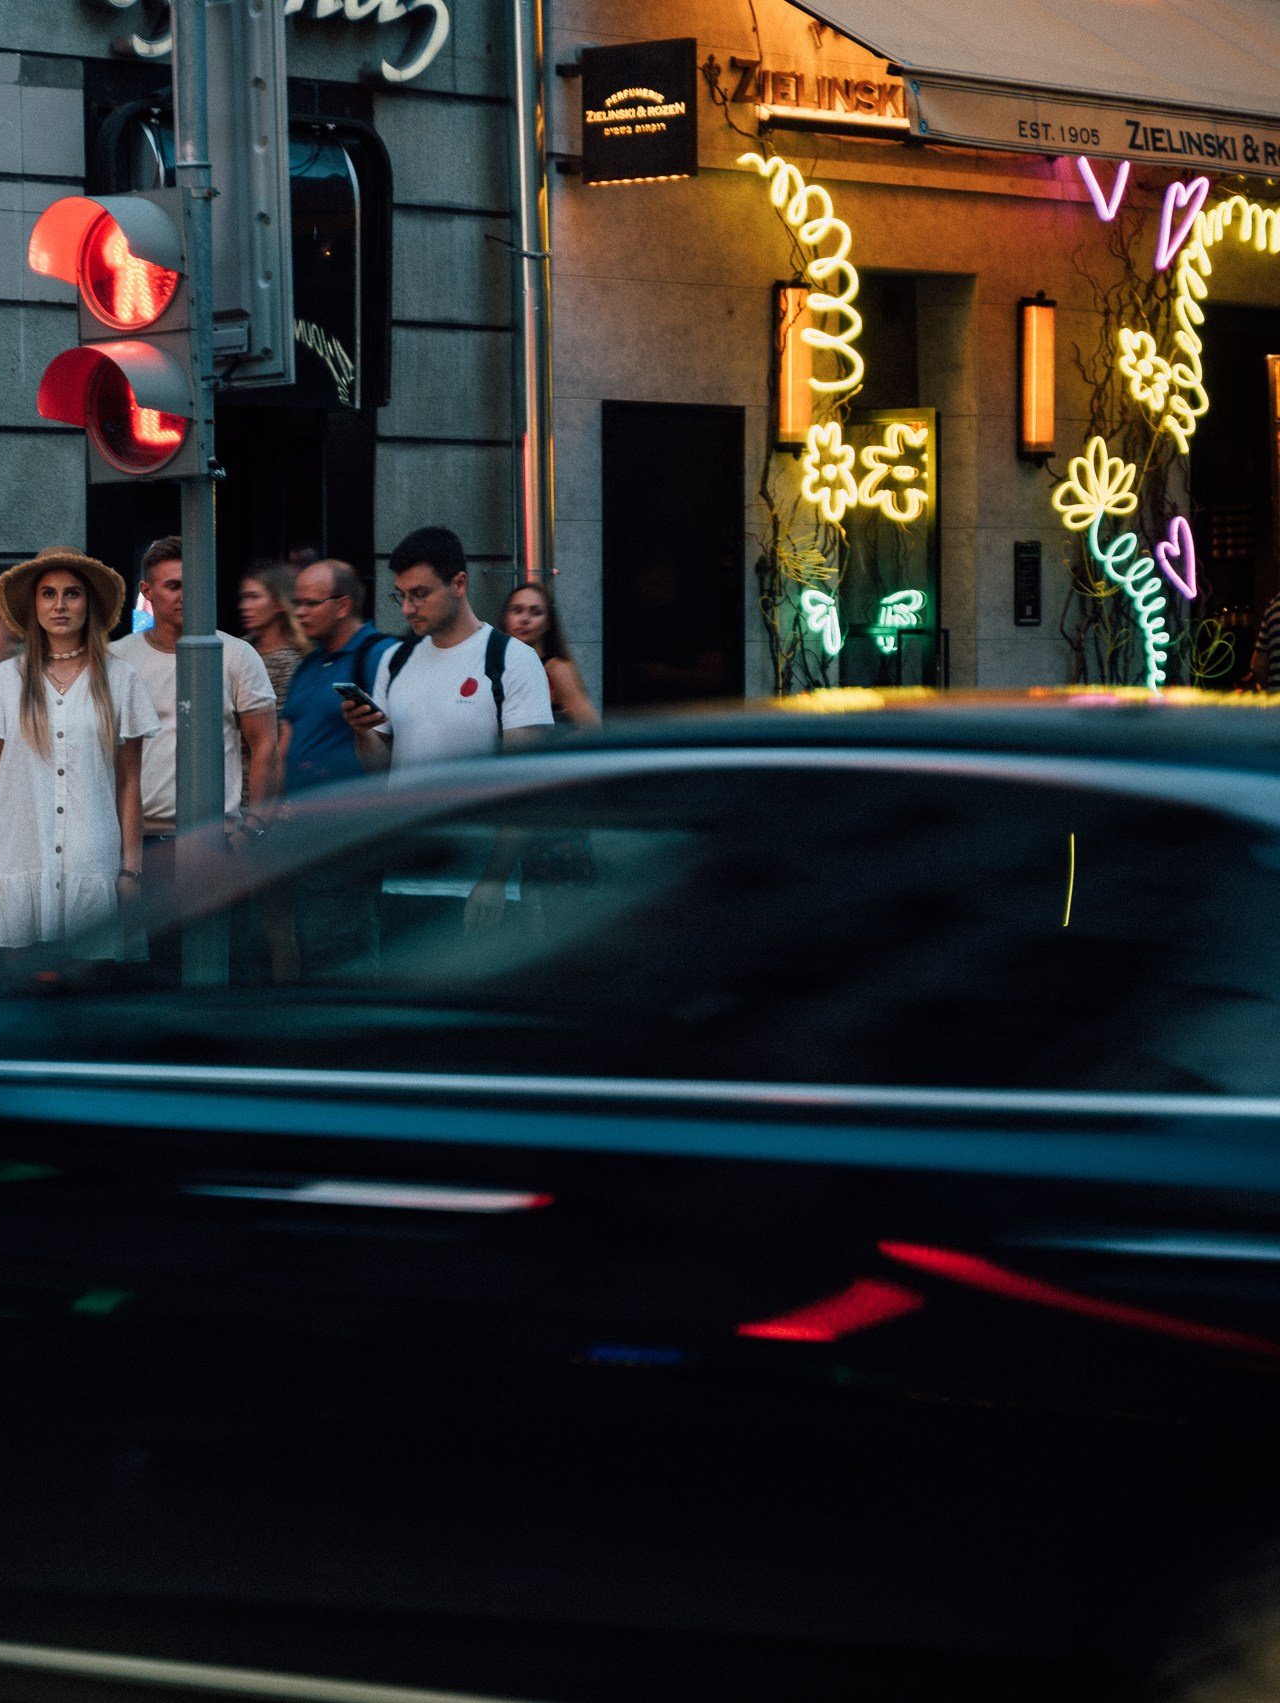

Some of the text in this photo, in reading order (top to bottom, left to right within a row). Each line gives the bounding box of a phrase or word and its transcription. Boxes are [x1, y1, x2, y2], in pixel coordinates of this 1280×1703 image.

[605, 87, 665, 108] PERFUMERIE
[585, 101, 686, 123] ZIELINSKI & ROZEN
[1017, 119, 1056, 142] EST.
[1060, 125, 1101, 146] 1905
[1125, 119, 1238, 161] ZIELINSKI
[1242, 133, 1261, 163] &
